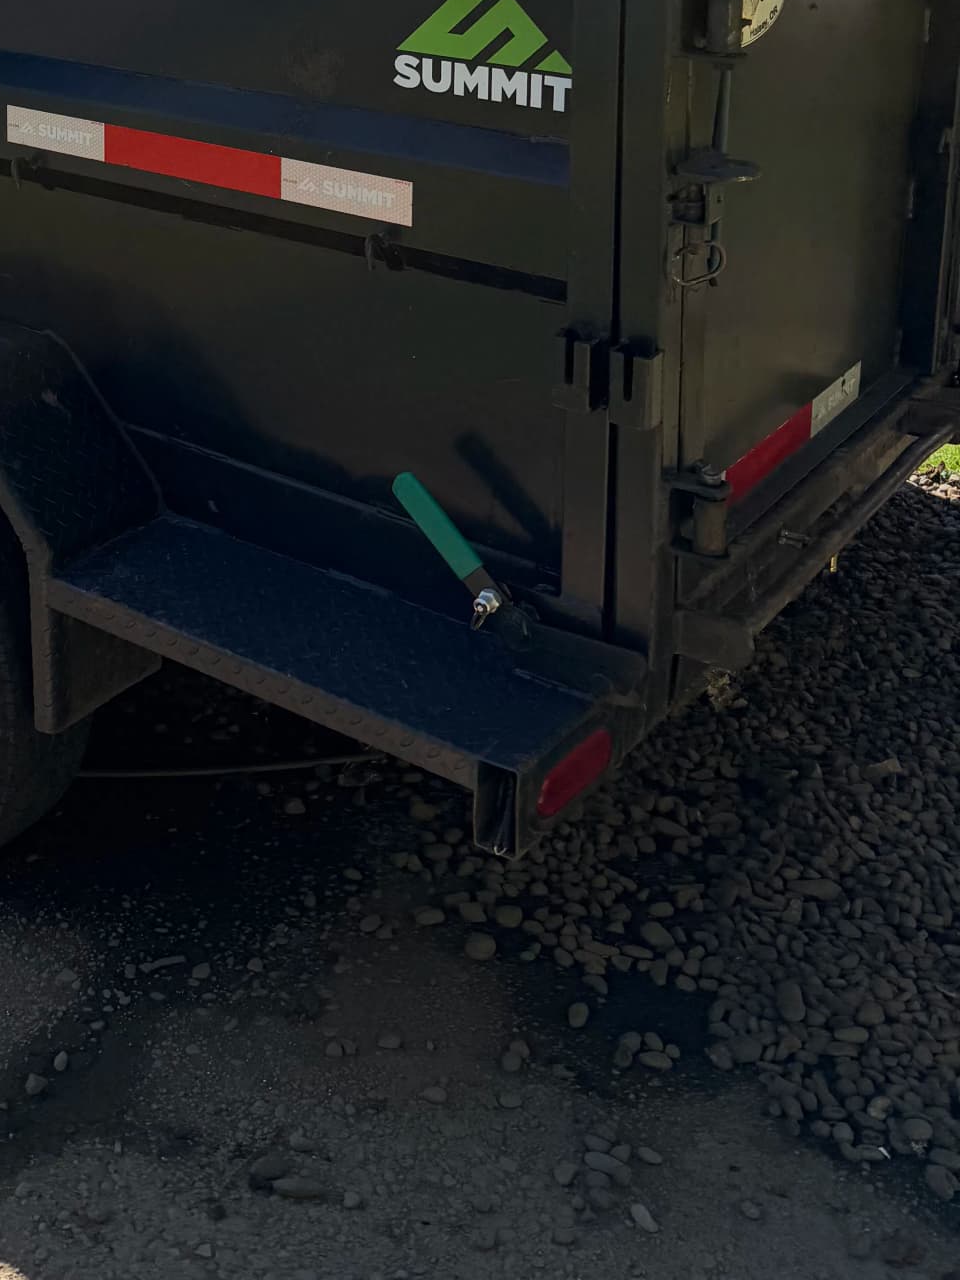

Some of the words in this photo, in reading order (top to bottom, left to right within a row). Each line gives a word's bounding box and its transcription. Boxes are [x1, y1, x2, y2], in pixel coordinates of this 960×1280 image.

[393, 54, 572, 112] SUMMIT
[38, 123, 93, 146] SUMMIT
[322, 180, 395, 208] SUMMIT
